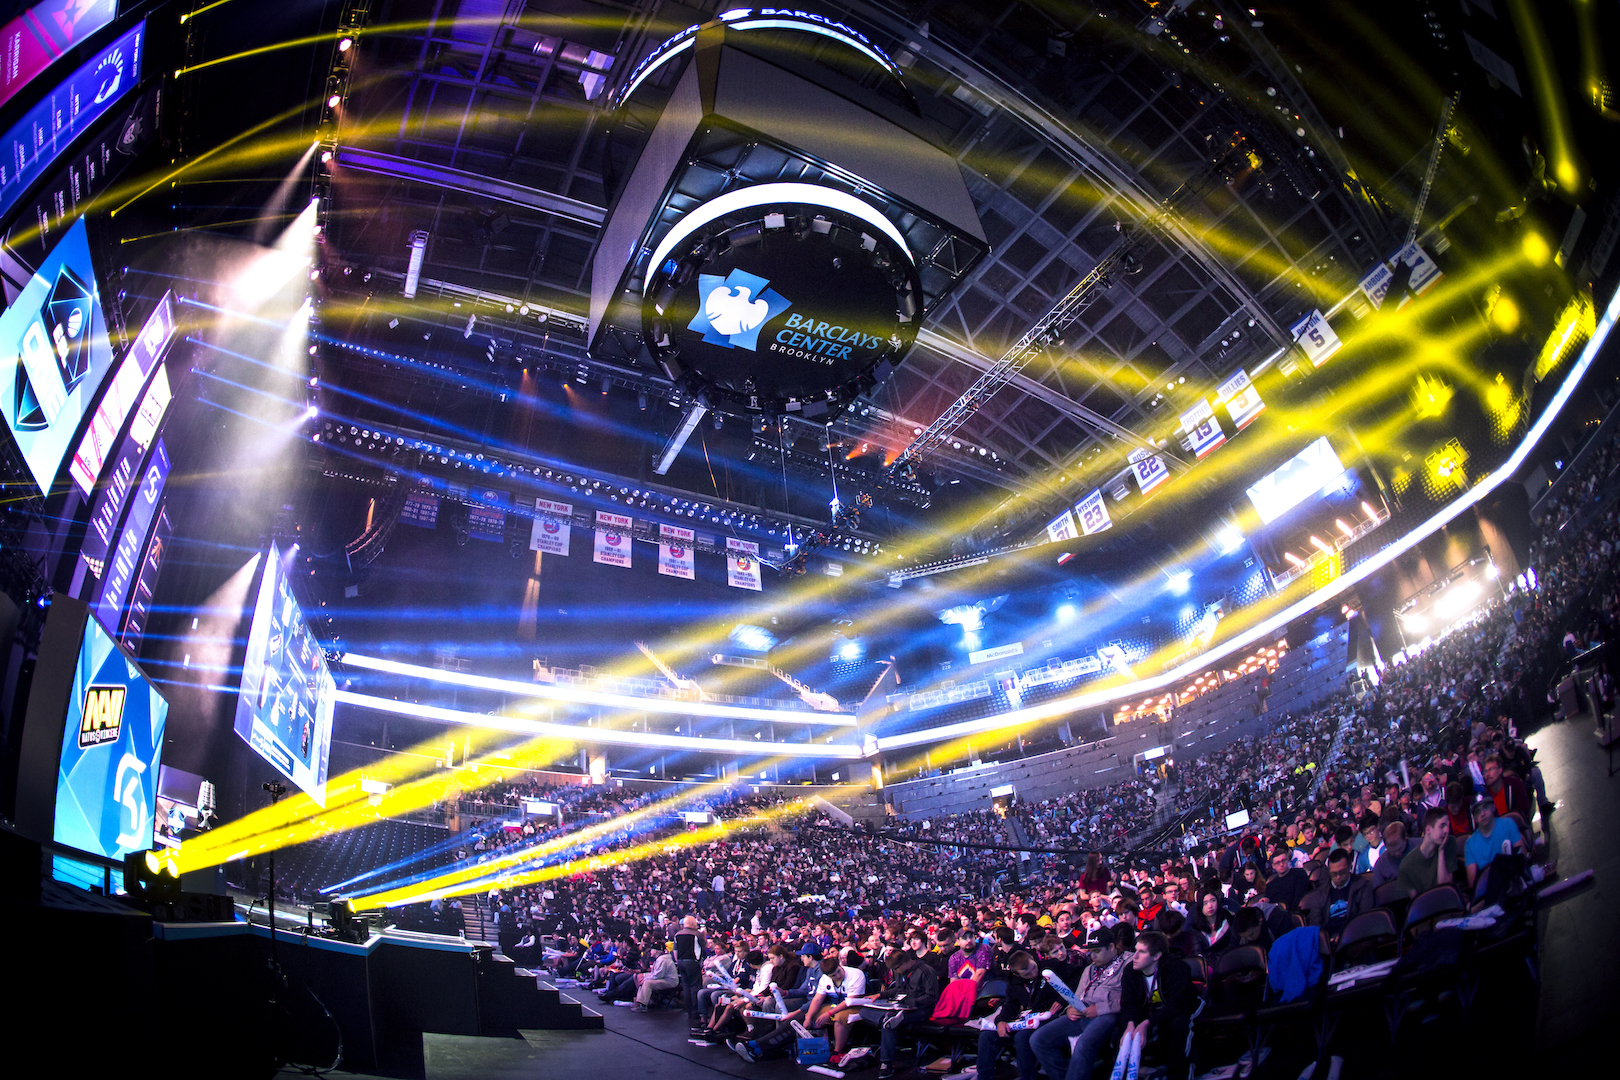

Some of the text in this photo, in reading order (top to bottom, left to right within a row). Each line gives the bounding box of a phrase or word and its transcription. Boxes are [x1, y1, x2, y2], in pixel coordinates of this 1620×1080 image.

[760, 7, 870, 43] BARCLAYS
[12, 31, 21, 79] KARRIGAN
[629, 23, 700, 81] CENTER
[1363, 267, 1388, 292] ARBOUR
[784, 312, 883, 350] BARCLAYS
[1308, 328, 1326, 348] 5
[53, 323, 69, 369] ESL
[769, 343, 835, 366] BROOKLYN
[775, 329, 853, 360] CENTER
[1182, 404, 1208, 427] TROTTIER
[1193, 417, 1213, 441] 19
[1137, 457, 1160, 480] 22
[539, 501, 568, 512] NEW YORK
[1077, 493, 1101, 514] NYSTROM
[600, 514, 628, 525] NEW YORK
[1052, 516, 1069, 533] SMITH
[1084, 504, 1103, 530] 23
[663, 526, 691, 538] NEW YORK
[537, 544, 561, 553] CHAMPIONS
[743, 542, 755, 550] YORK
[601, 556, 624, 565] CHAMPIONS
[665, 562, 680, 570] STANLEY
[665, 568, 688, 577] CHAMPIONS
[734, 580, 756, 588] CHAMPIONS
[986, 647, 1018, 659] McDonald's
[82, 690, 125, 731] NAVI
[81, 728, 119, 743] NATUS VINCERE
